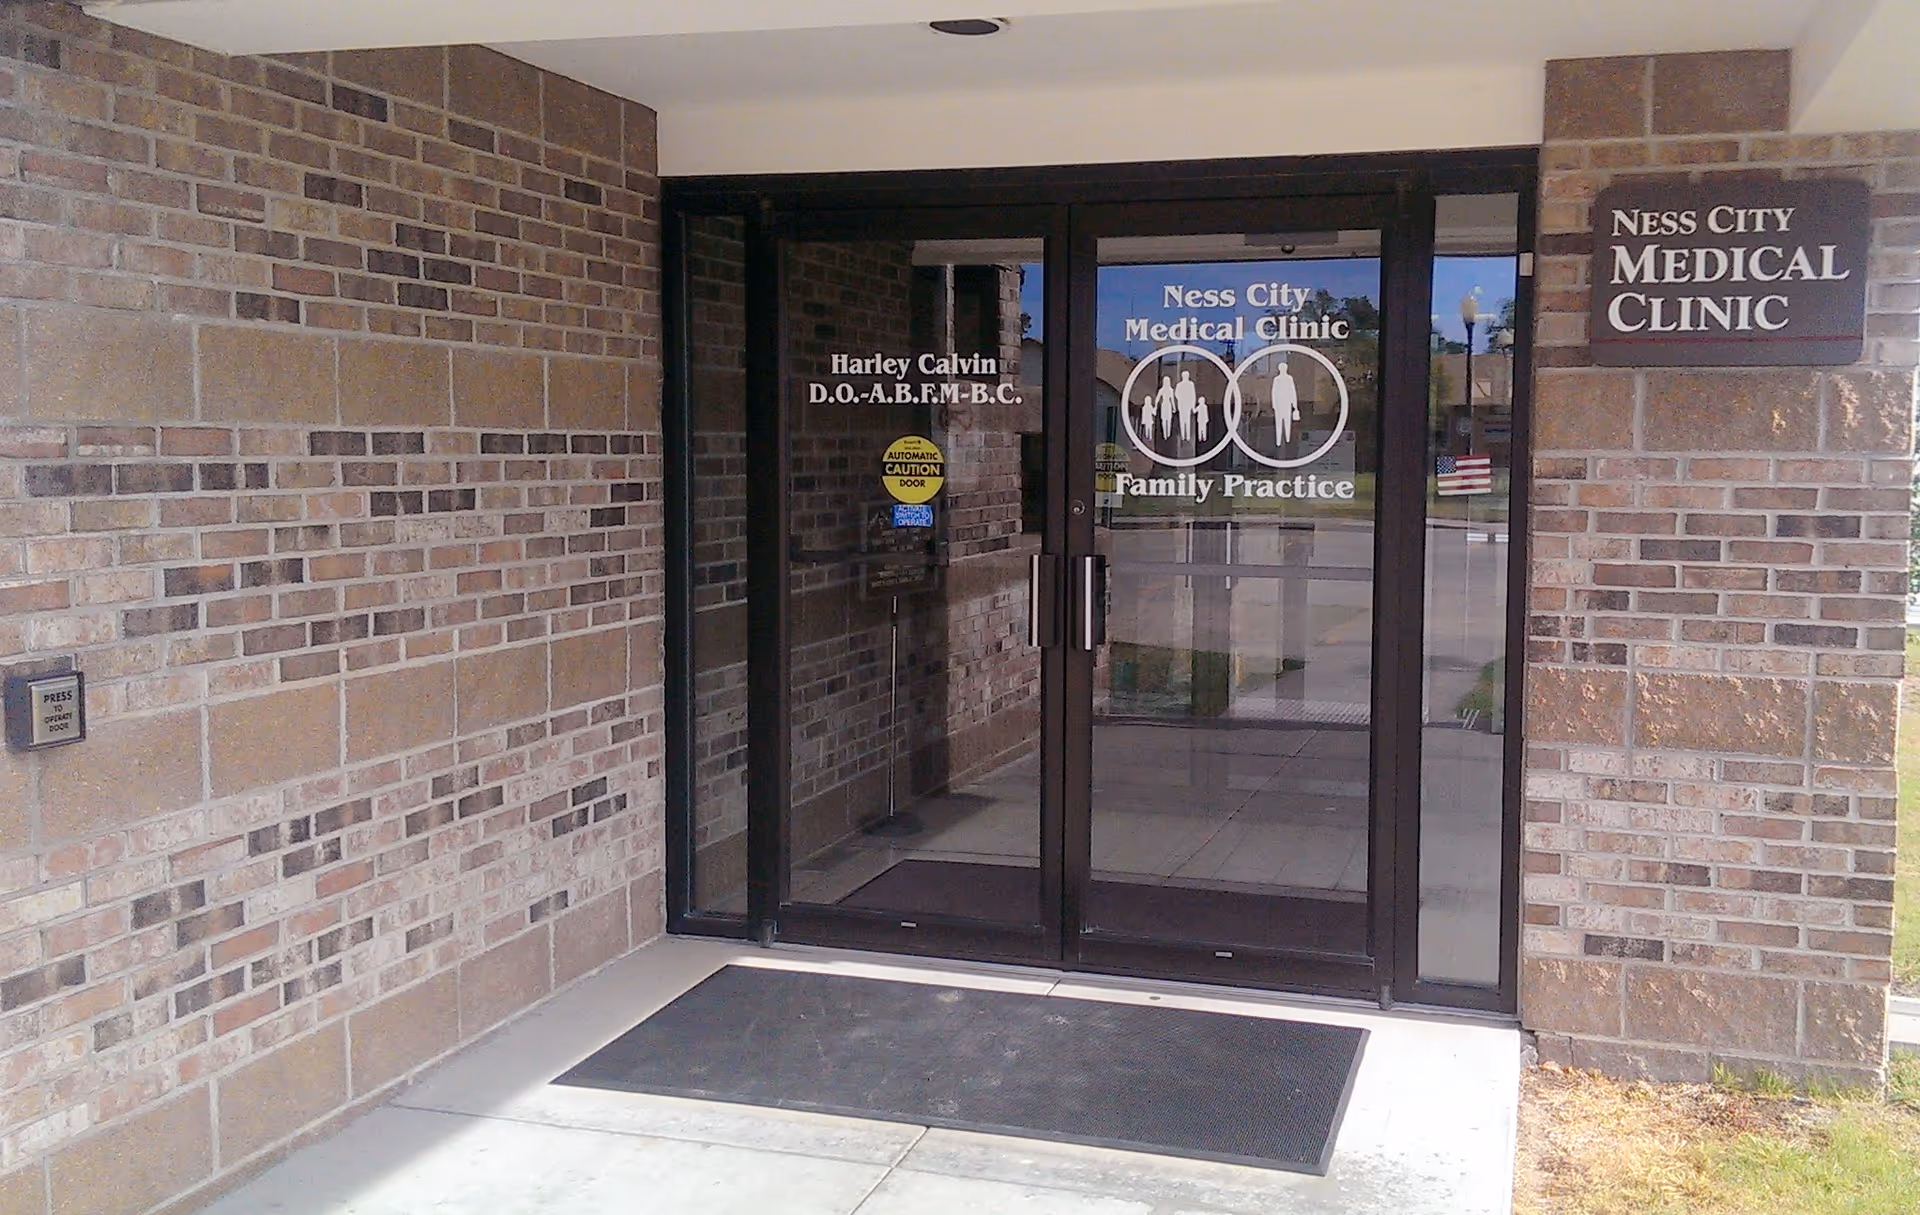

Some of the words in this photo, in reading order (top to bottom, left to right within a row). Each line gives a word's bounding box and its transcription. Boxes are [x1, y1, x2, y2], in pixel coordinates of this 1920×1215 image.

[1611, 208, 1697, 237] NESS
[1707, 204, 1796, 234] CITY
[1609, 243, 1851, 285] MEDICAL
[1162, 284, 1236, 308] Ness
[1246, 282, 1311, 312] City
[1607, 292, 1790, 333] CLINIC
[1125, 316, 1245, 342] Medical
[1255, 314, 1350, 341] Clinic
[830, 353, 911, 380] Harley
[917, 352, 998, 375] Calvin
[885, 463, 940, 476] CAUTION
[887, 451, 938, 460] AUTOMATIC
[899, 479, 926, 488] DOOR
[1115, 472, 1215, 503] Family
[1223, 473, 1355, 499] Practice
[43, 690, 73, 703] PRESS
[54, 704, 63, 712] TO
[49, 723, 69, 732] DOOR
